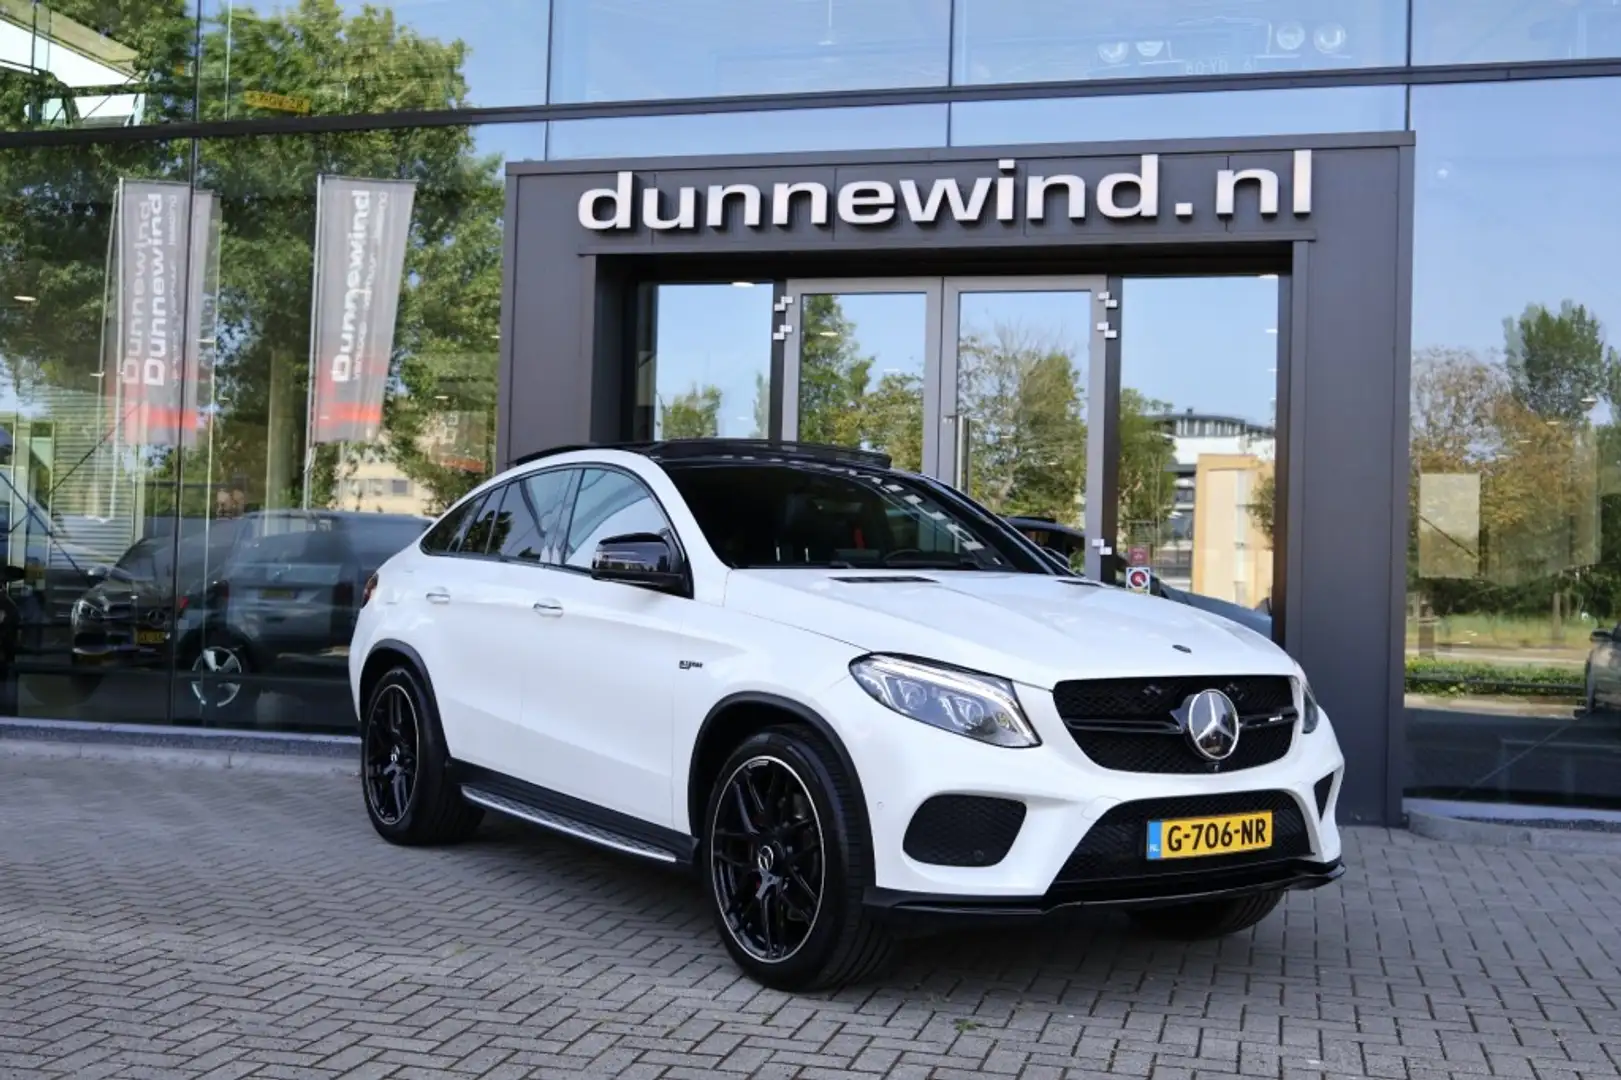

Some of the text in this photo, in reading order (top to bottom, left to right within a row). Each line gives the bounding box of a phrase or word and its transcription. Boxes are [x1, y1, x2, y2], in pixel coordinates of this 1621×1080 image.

[577, 149, 1312, 230] dunnewind.nl
[143, 193, 166, 386] Dunnewind
[331, 190, 370, 382] Dunnewind
[1167, 818, 1267, 852] G-706-NR
